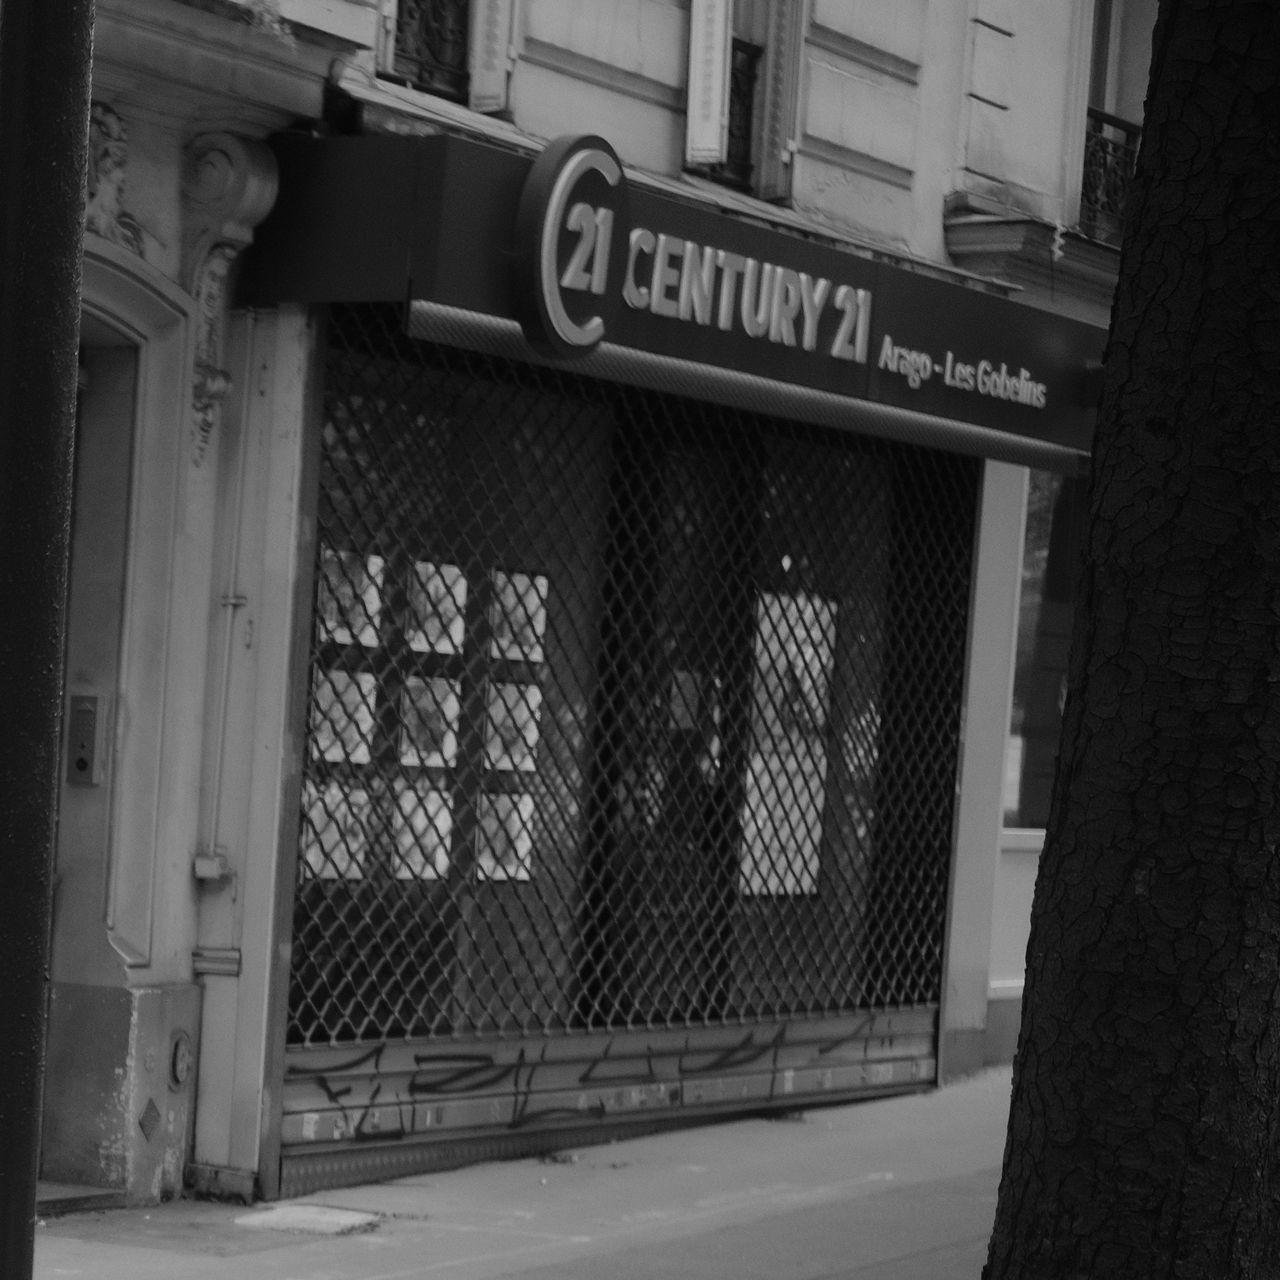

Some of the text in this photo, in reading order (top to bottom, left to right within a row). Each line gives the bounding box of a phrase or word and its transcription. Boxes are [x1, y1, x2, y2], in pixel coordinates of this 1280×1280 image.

[622, 227, 872, 364] CENTURY 21
[877, 333, 933, 390] Arago
[944, 350, 976, 391] Les
